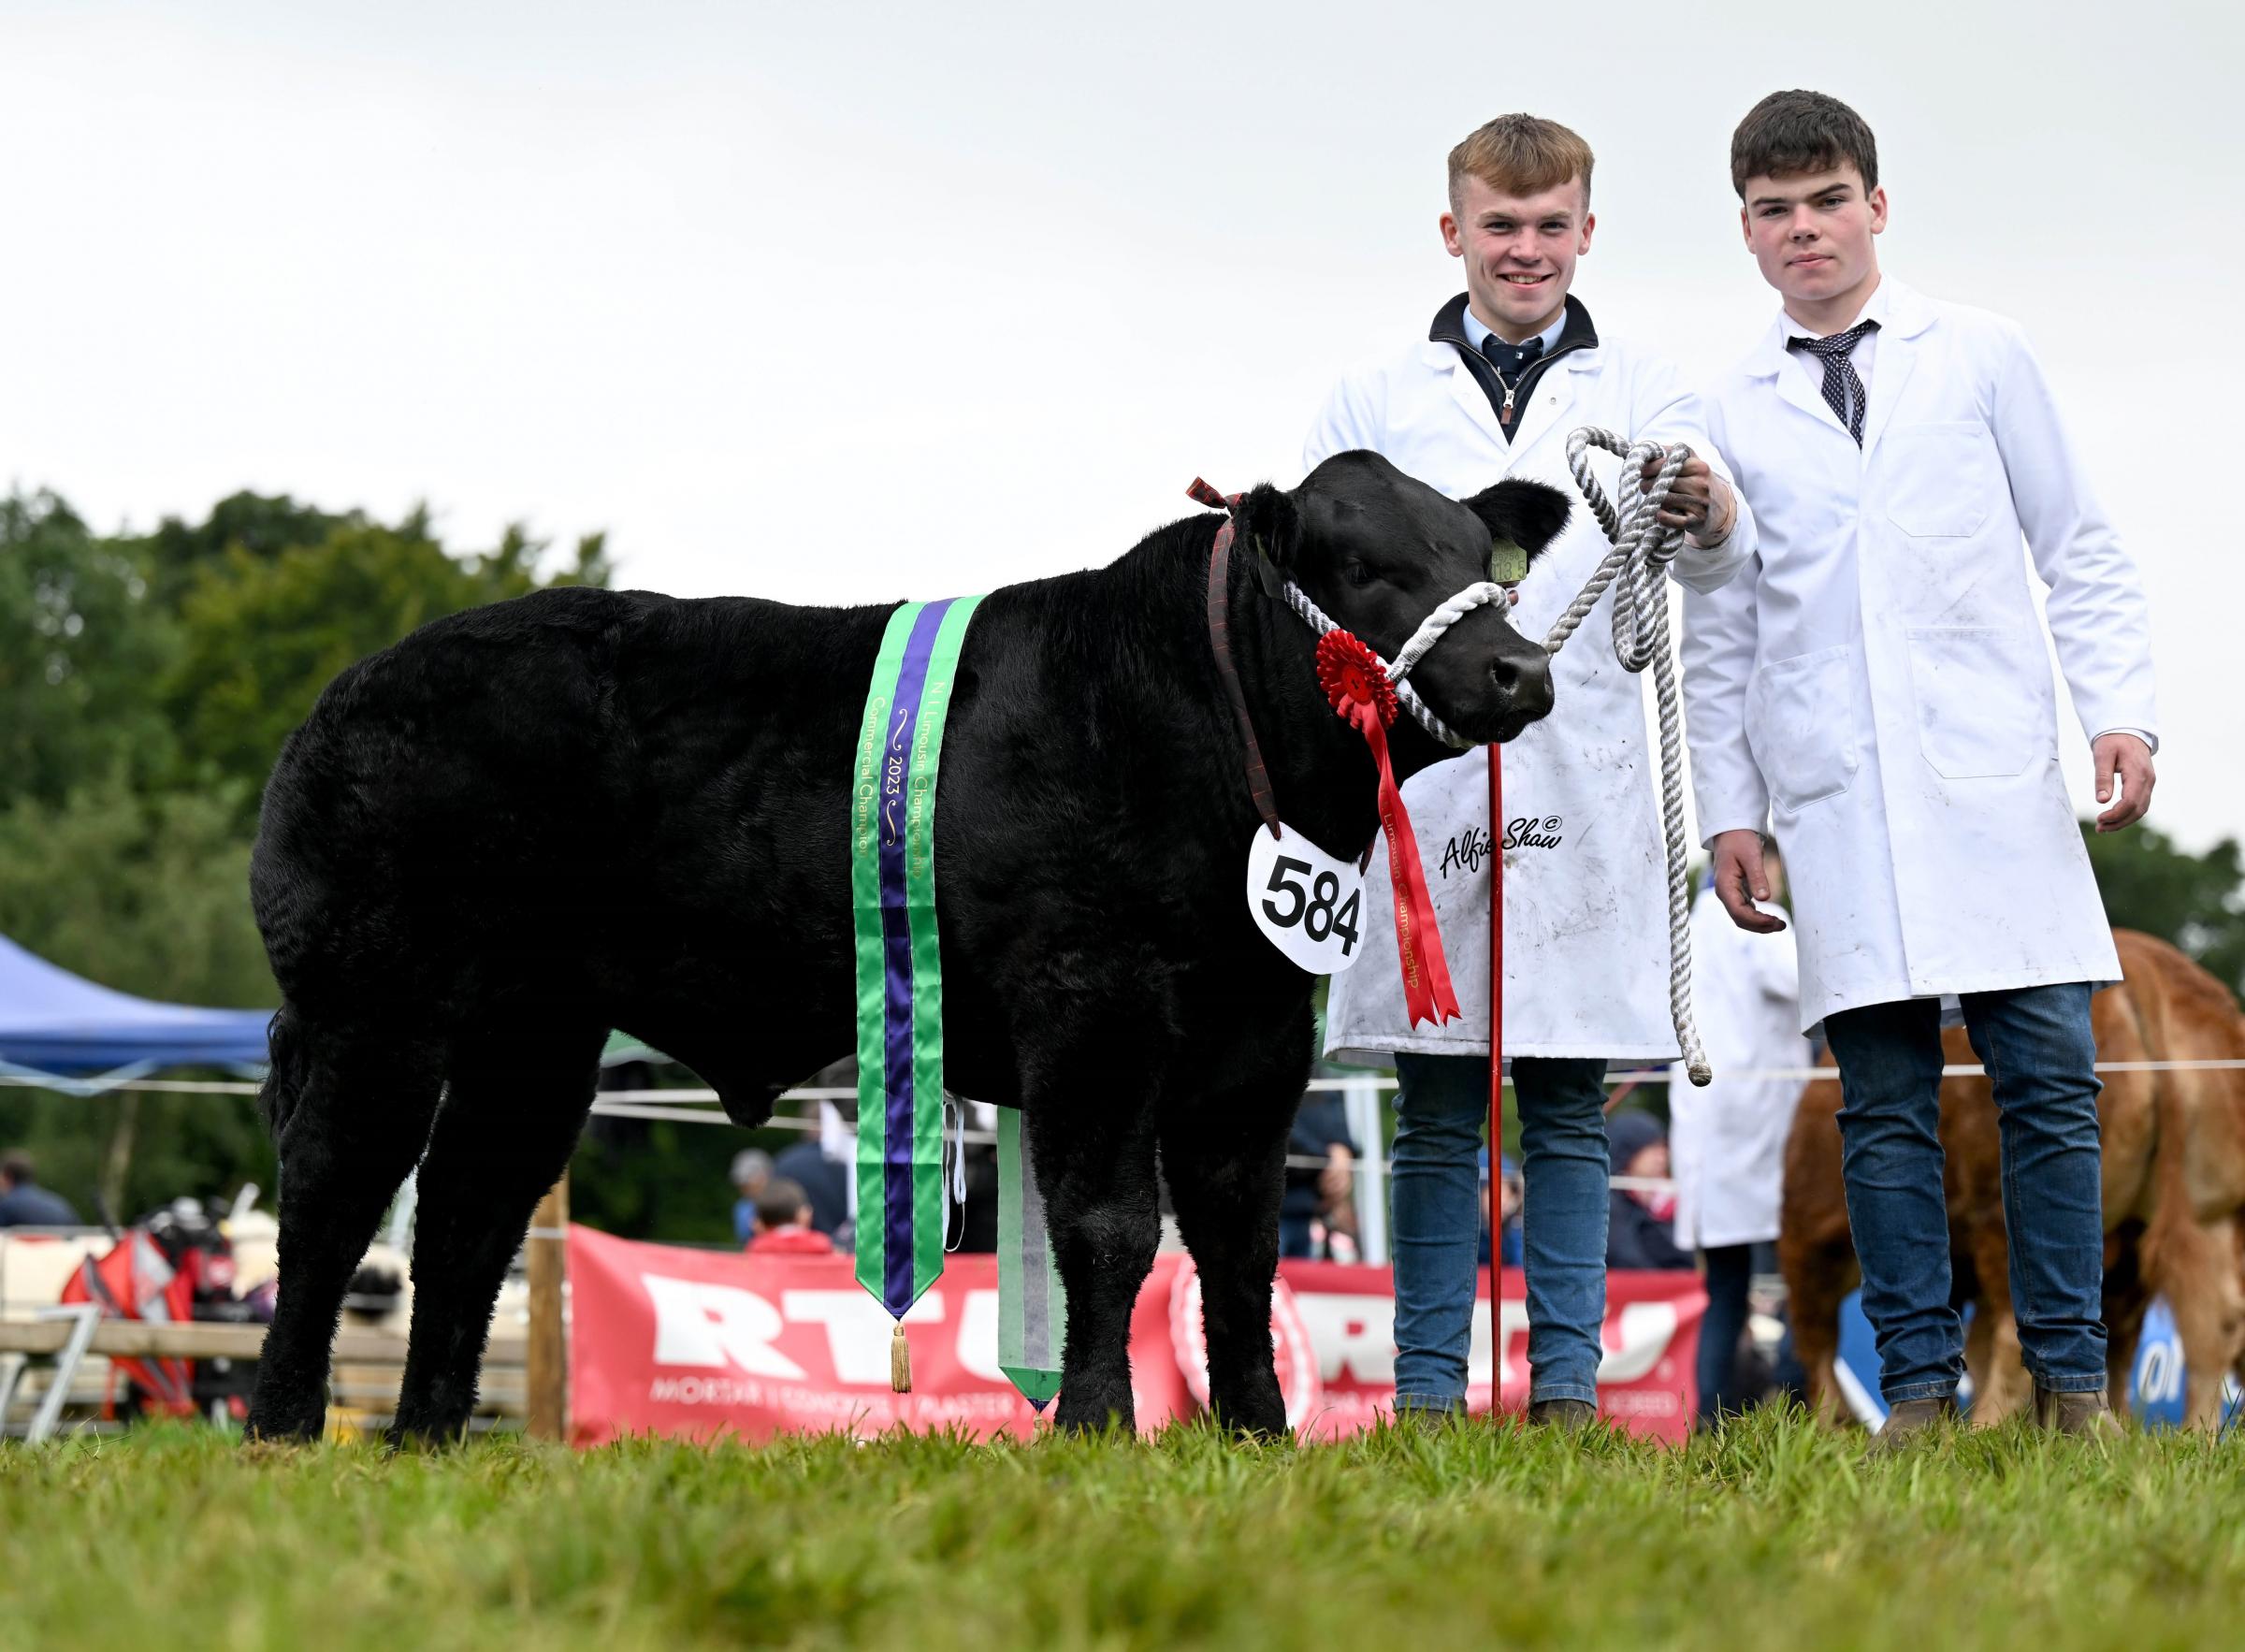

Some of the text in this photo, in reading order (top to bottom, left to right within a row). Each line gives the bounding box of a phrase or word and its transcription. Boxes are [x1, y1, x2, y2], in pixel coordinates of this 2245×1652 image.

[932, 681, 945, 694] N
[856, 696, 885, 859] Commercial Champion
[886, 757, 903, 795] 2023
[916, 711, 936, 773] Limousin
[912, 777, 928, 880] Championship
[1262, 855, 1361, 957] 584
[1383, 814, 1401, 880] Limousin
[1398, 882, 1419, 990] Championship
